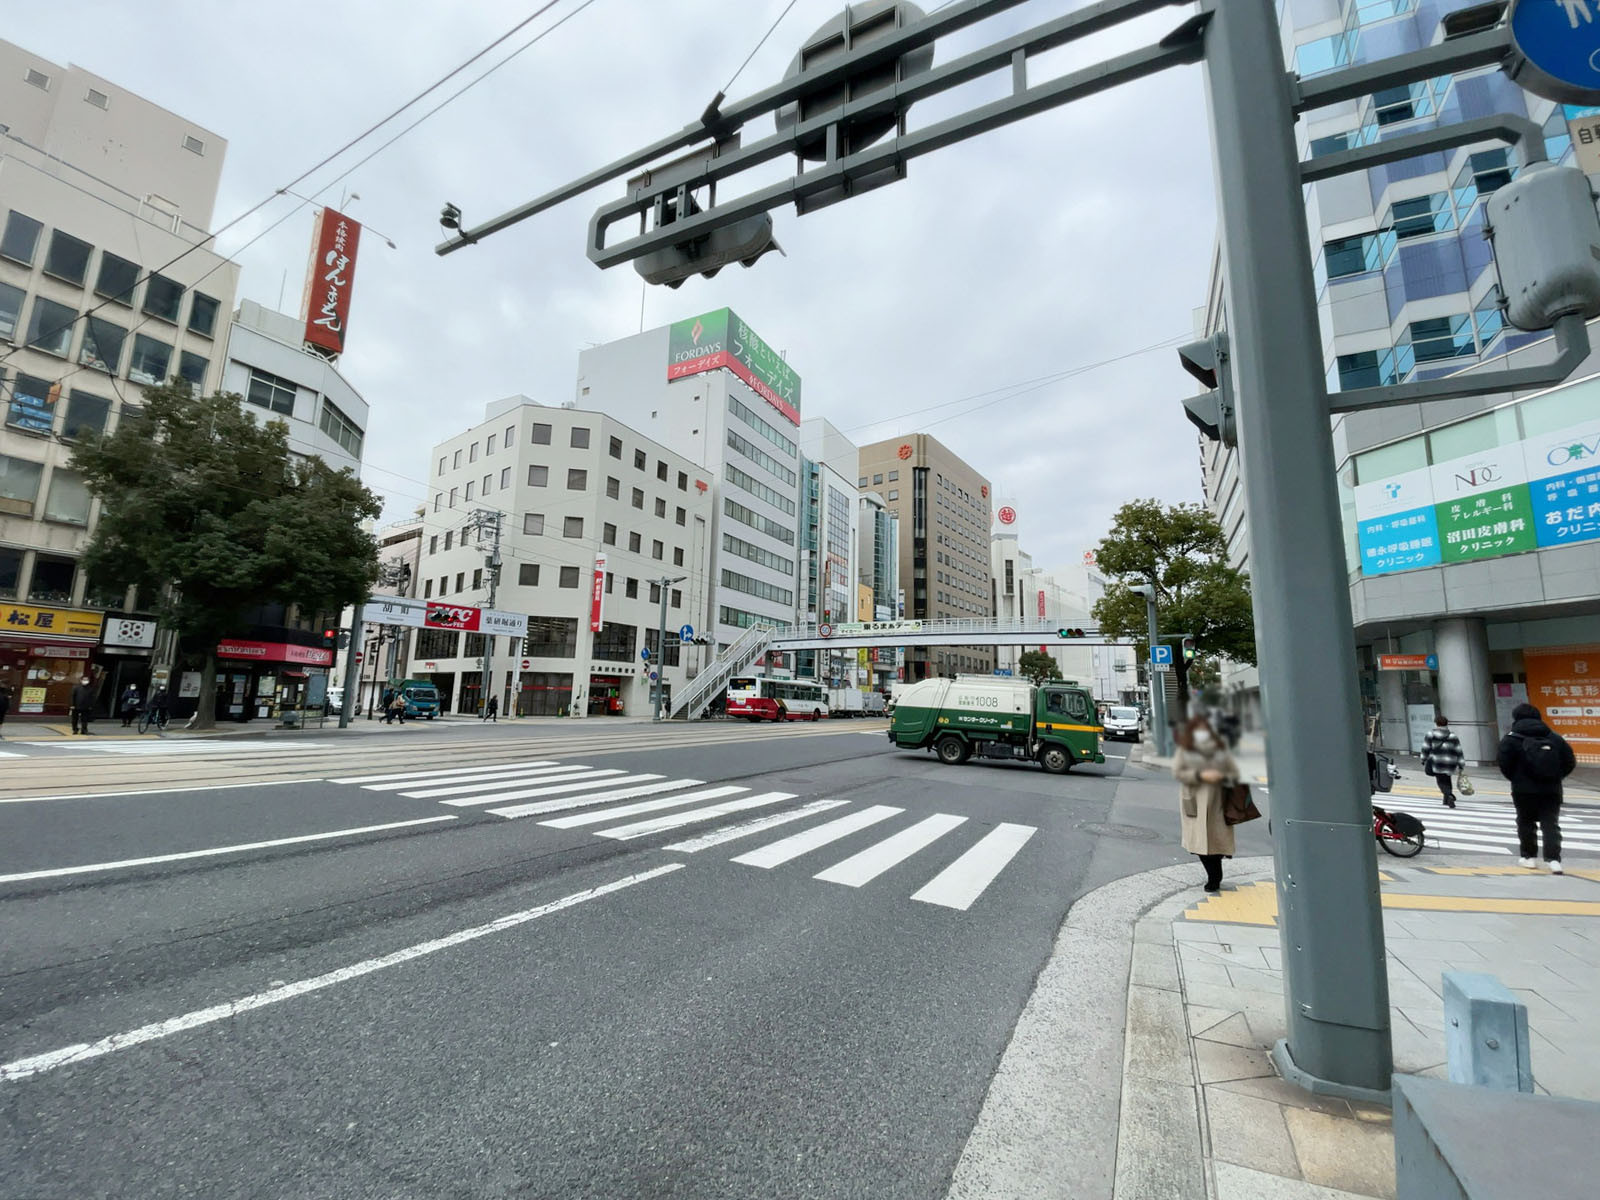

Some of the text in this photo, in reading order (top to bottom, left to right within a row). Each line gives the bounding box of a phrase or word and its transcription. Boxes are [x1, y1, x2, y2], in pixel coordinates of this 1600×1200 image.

[675, 342, 721, 363] FORDAYS
[1455, 464, 1502, 491] NDC
[1447, 518, 1526, 544] 沼田皮膚科
[1557, 521, 1600, 537] クリニ
[1460, 537, 1515, 554] クリニック
[1377, 553, 1424, 568] クリニック
[7, 609, 55, 629] 松屋
[1156, 648, 1168, 662] P
[975, 696, 999, 708] 1008
